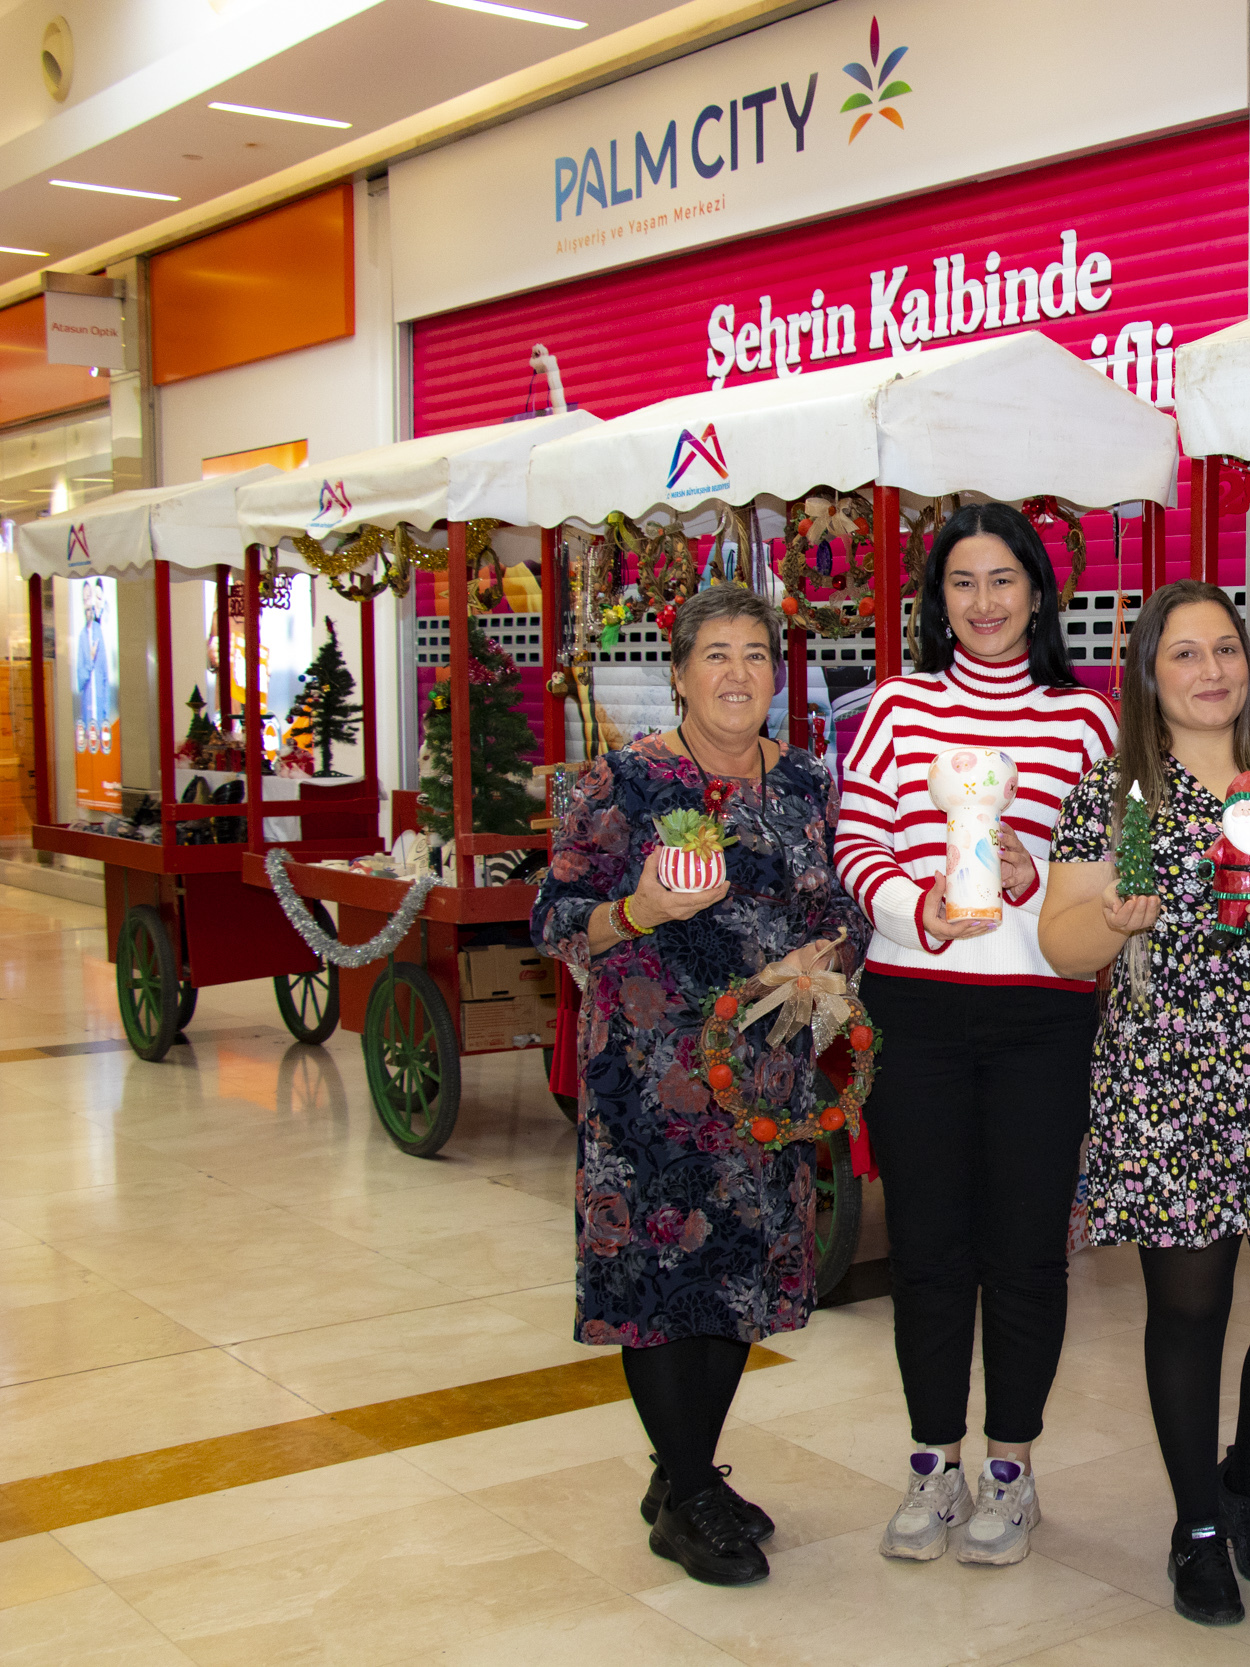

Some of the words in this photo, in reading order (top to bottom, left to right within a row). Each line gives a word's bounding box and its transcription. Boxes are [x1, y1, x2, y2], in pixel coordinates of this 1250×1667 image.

[555, 119, 677, 223] PALM
[691, 72, 819, 179] CITY
[555, 224, 606, 254] Alışveriş
[611, 225, 624, 240] ve
[628, 214, 668, 237] Yaşam
[674, 193, 726, 223] Merkezi
[51, 322, 89, 335] Atasun
[90, 325, 118, 338] Optik
[706, 289, 858, 391] Şehrin
[869, 229, 1113, 358] Kalbinde
[1082, 319, 1176, 408] ifli
